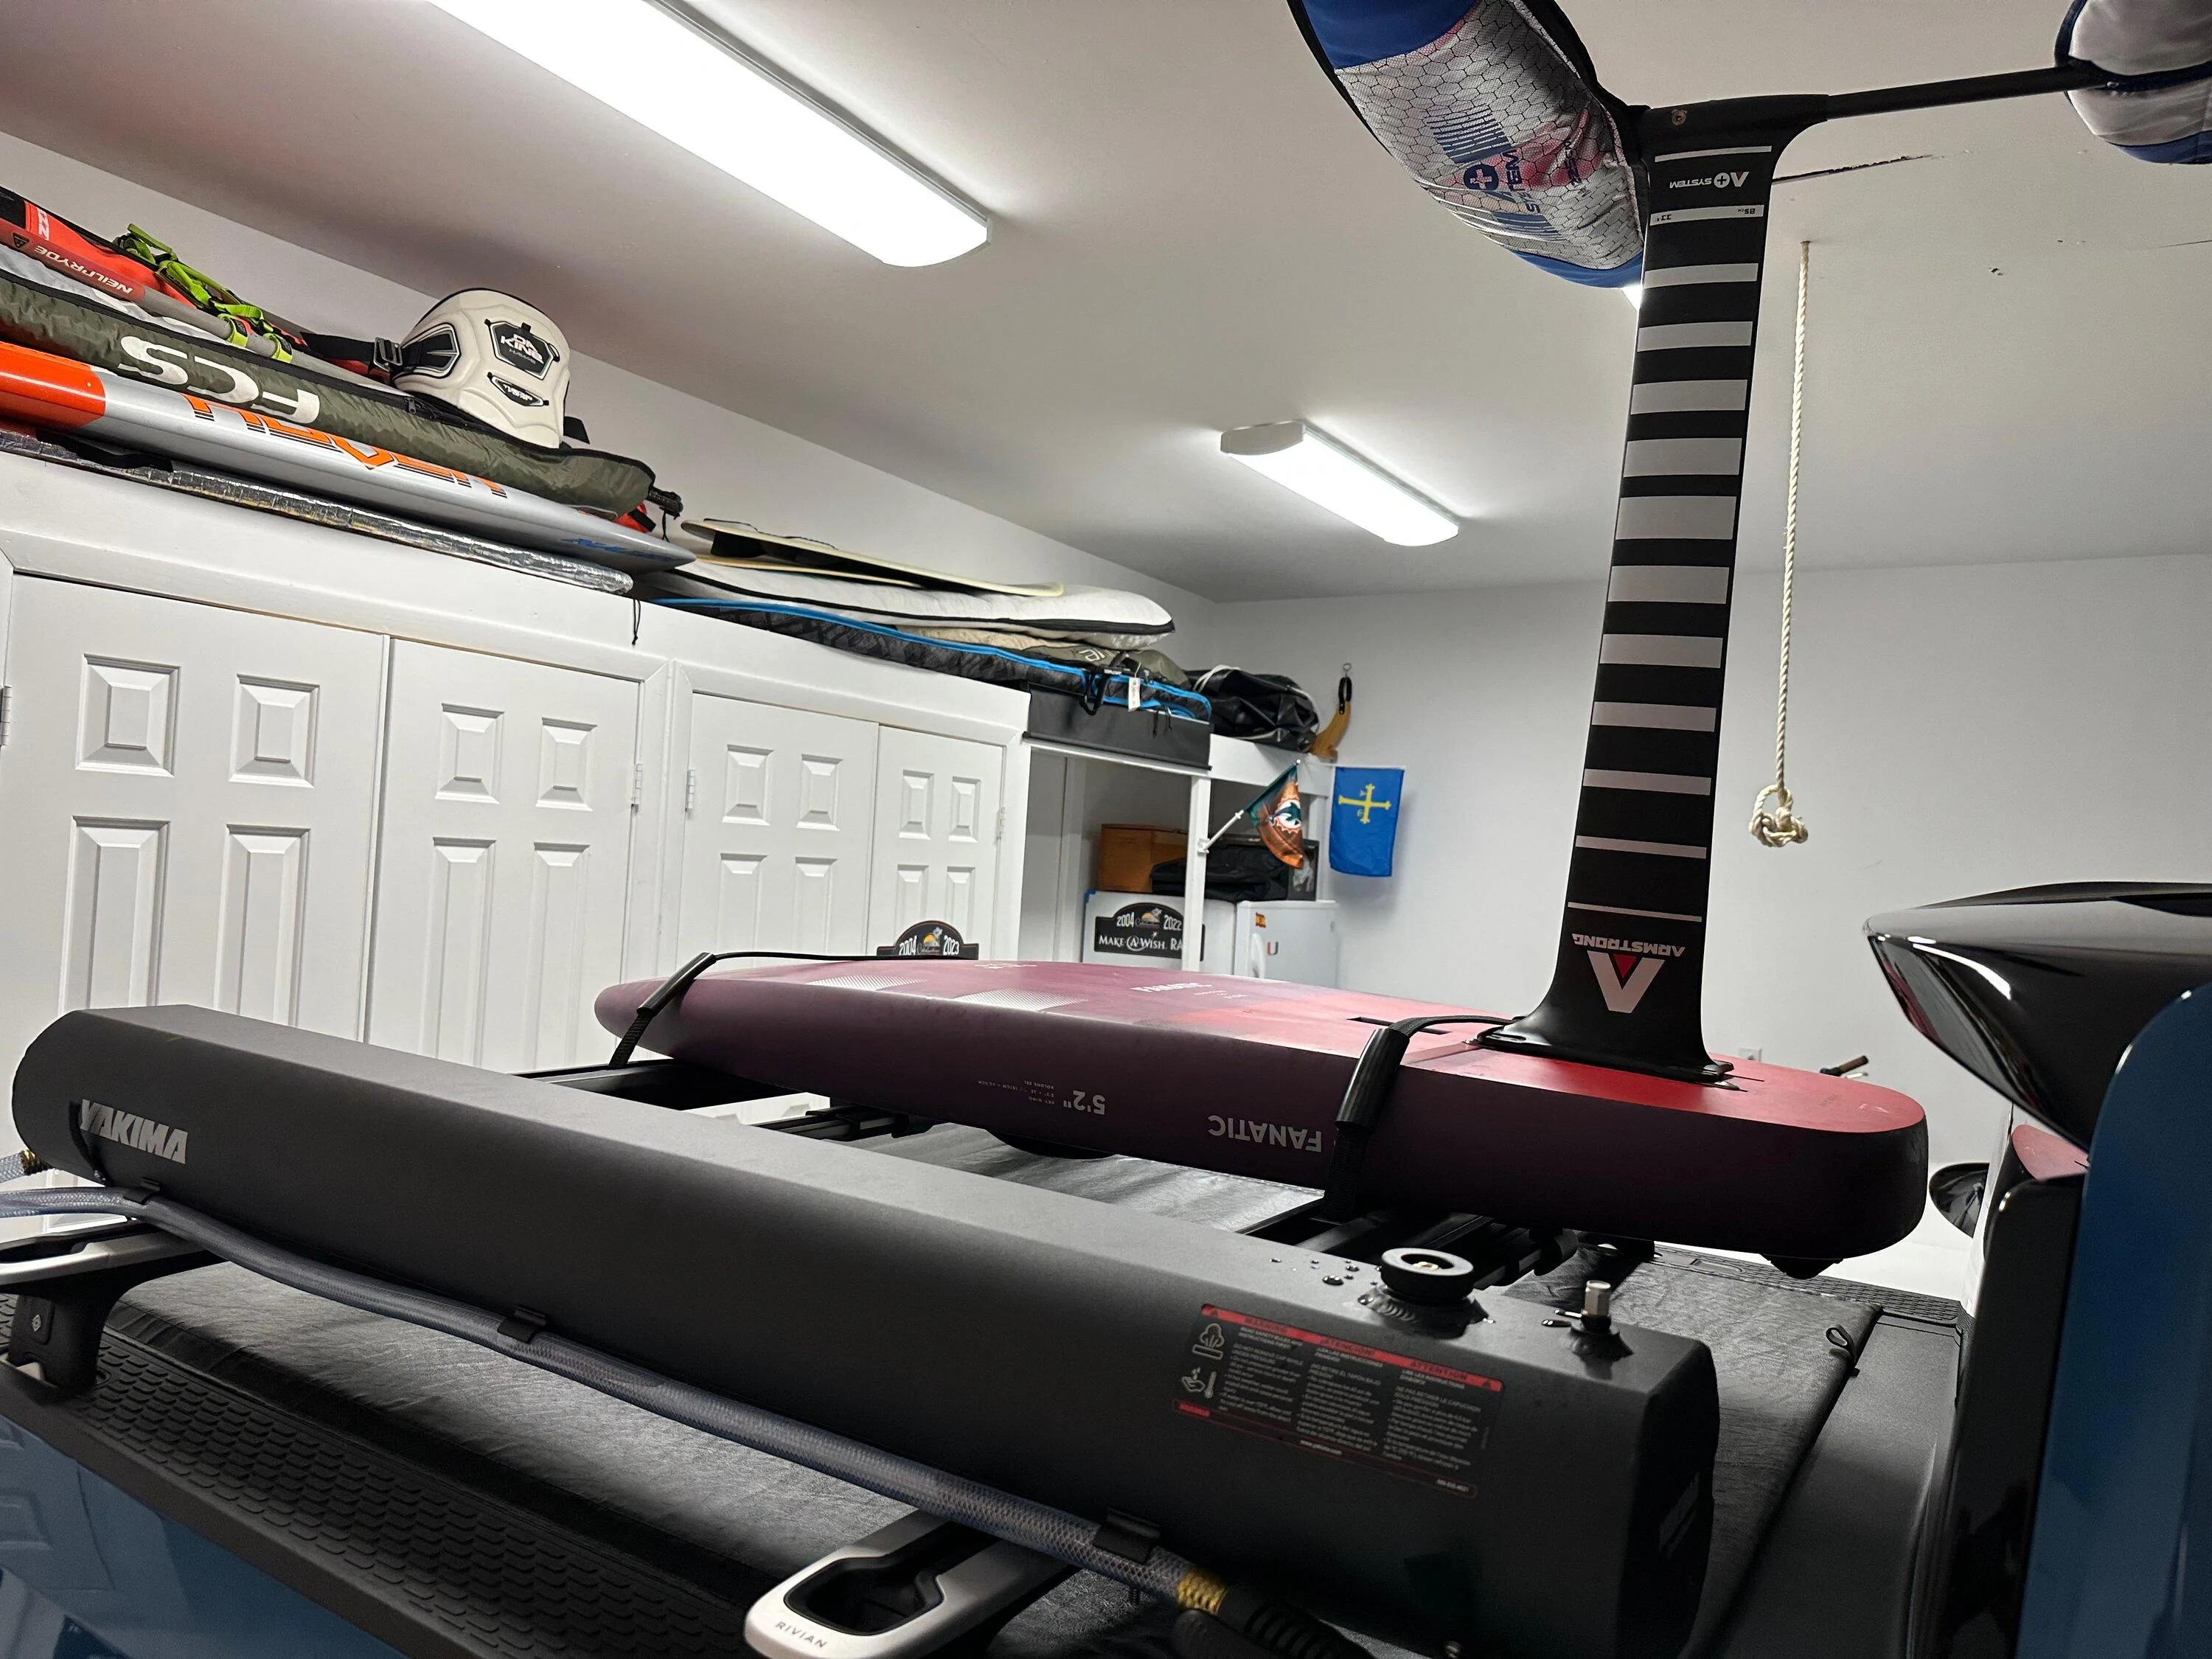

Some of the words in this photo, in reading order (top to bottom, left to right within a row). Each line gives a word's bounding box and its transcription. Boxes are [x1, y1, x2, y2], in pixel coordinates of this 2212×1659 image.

[1669, 177, 1713, 189] SYSTEM
[34, 244, 134, 294] NEILPRYDE
[117, 335, 320, 424] FCS
[1116, 911, 1135, 928] 2004
[1163, 914, 1182, 931] 2022
[899, 935, 917, 956] 2004
[943, 934, 960, 956] 2023
[1571, 933, 1686, 958] ARMSTRONG
[80, 1099, 188, 1164] YAKIMA
[1207, 1114, 1323, 1153] FANATIC
[775, 1621, 827, 1648] RIVIAN
